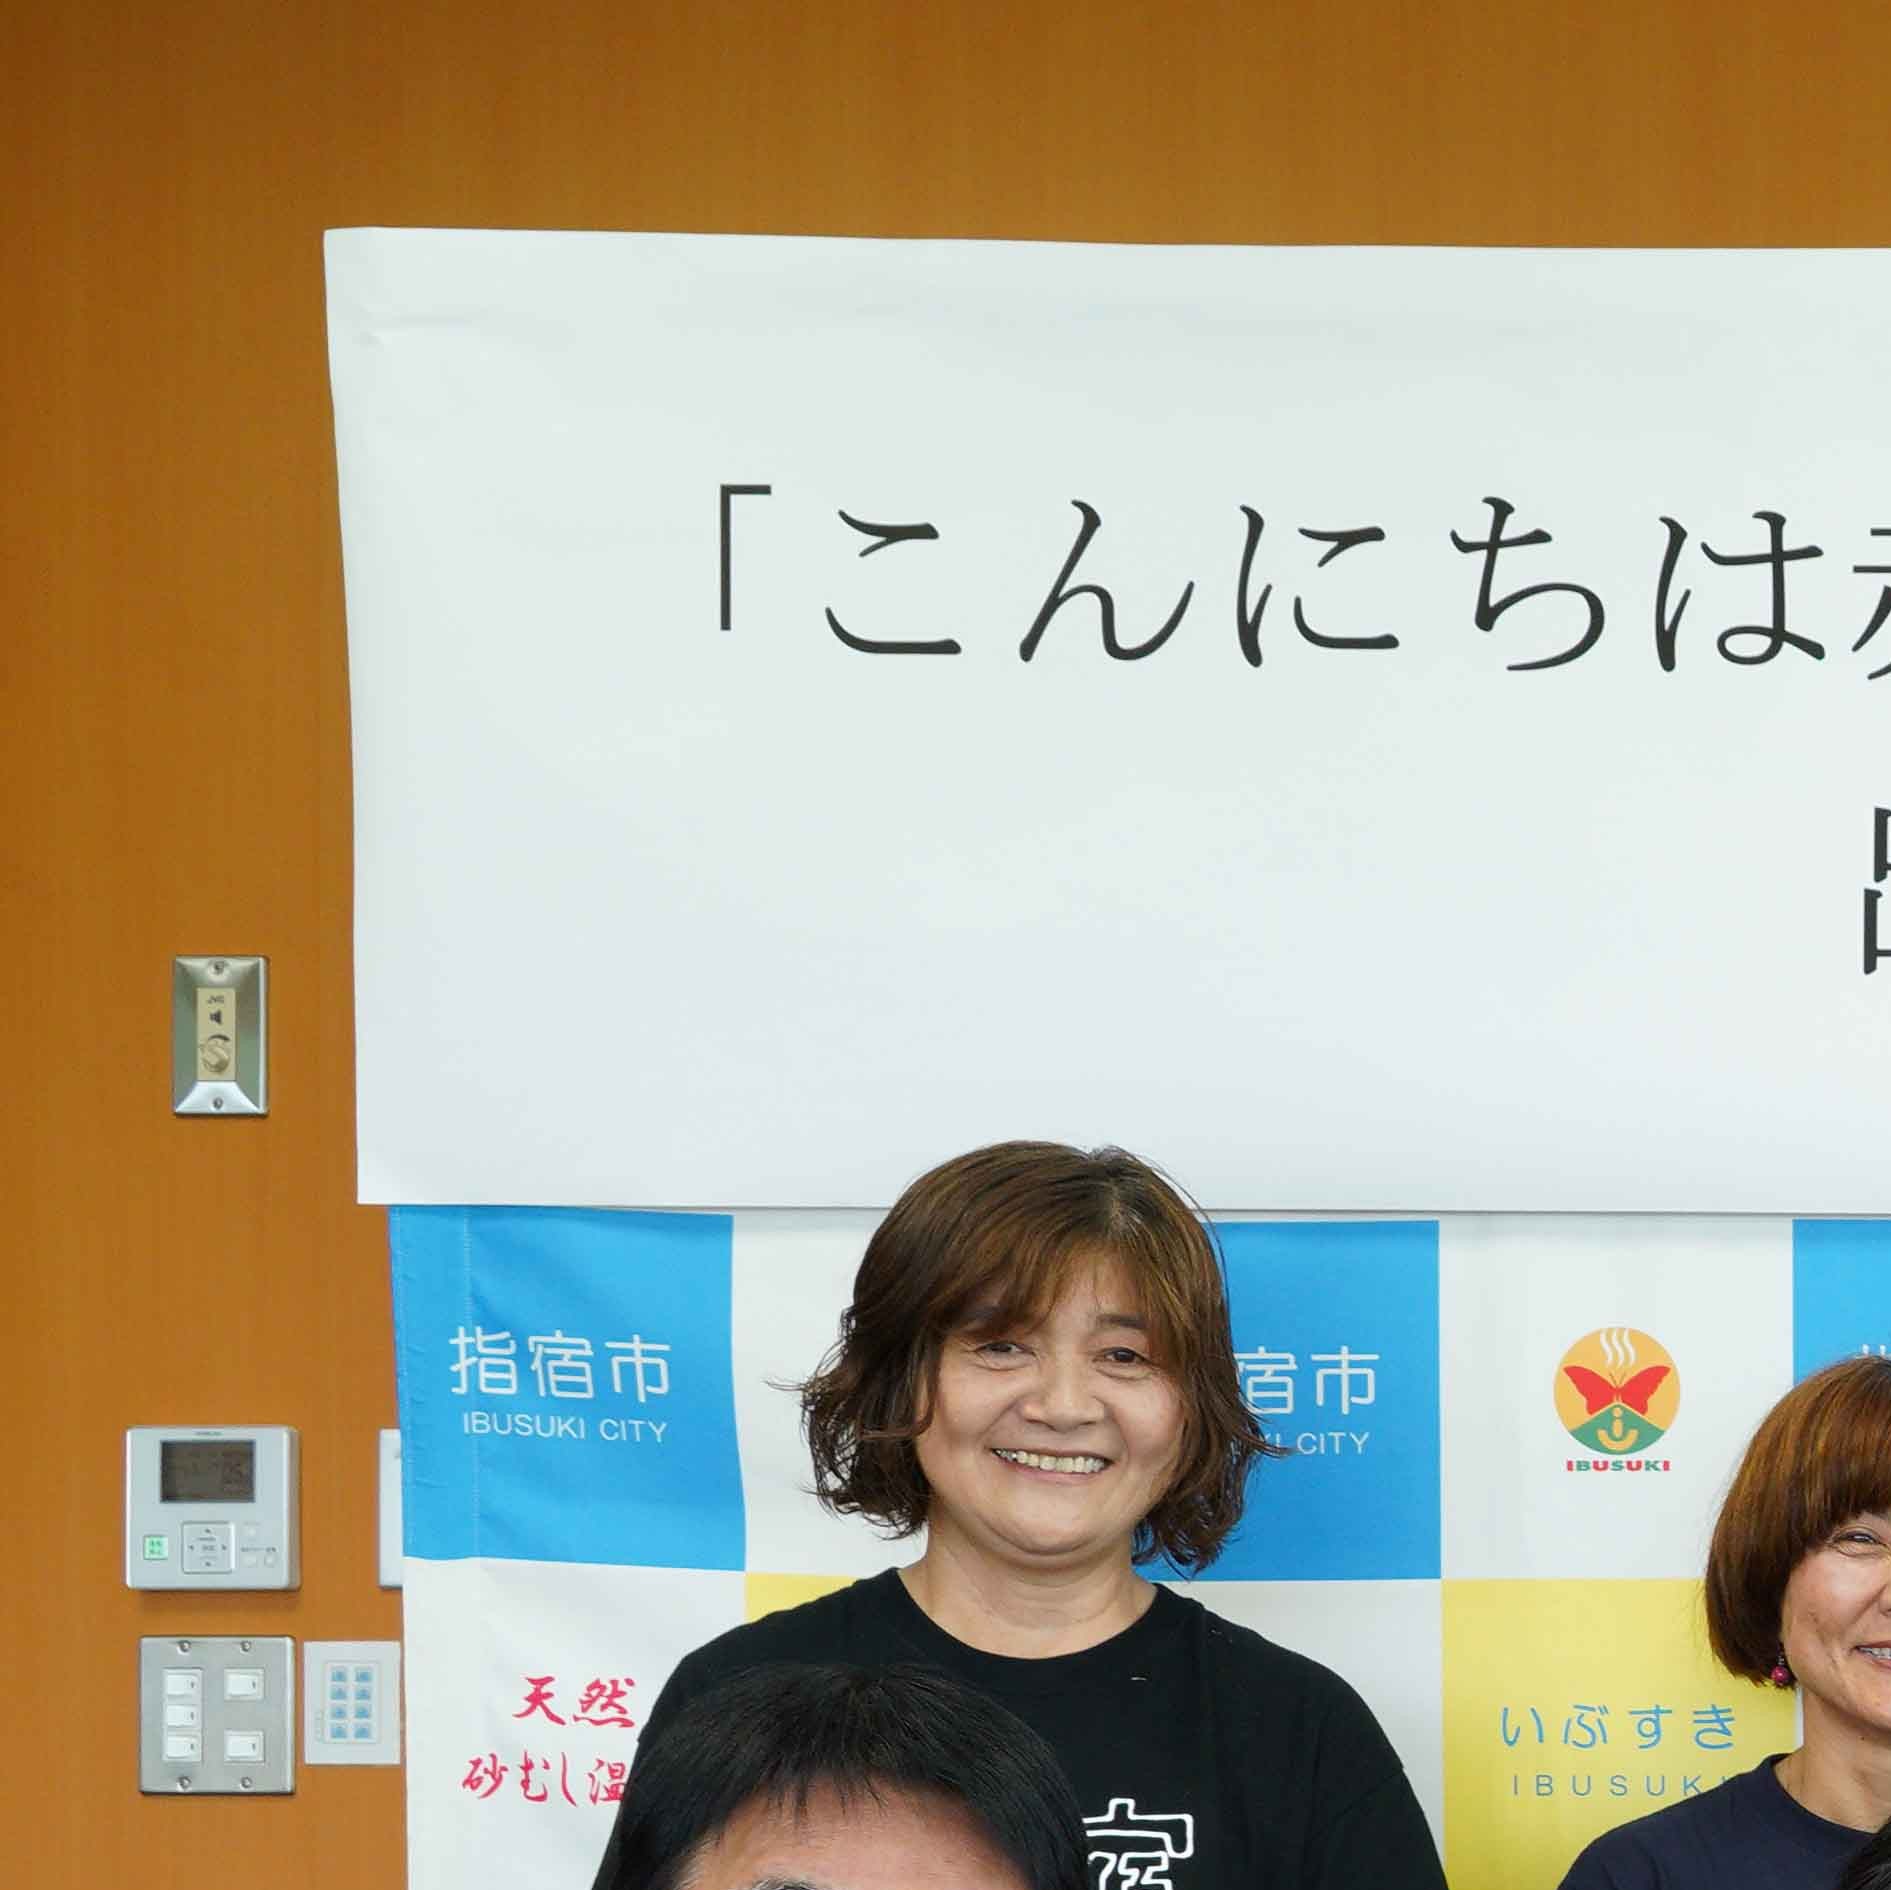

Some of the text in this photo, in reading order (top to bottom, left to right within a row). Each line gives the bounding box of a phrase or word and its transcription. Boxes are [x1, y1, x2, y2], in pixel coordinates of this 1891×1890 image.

[451, 1328, 671, 1403] 指宿市
[465, 1413, 667, 1443] IBUSUKI CITY
[1297, 1432, 1370, 1455] CITY
[1566, 1459, 1671, 1472] IBUSUKI
[516, 1677, 635, 1728] 天然
[1504, 1705, 1735, 1750] いぶすき
[1513, 1774, 1735, 1797] IBUSUK
